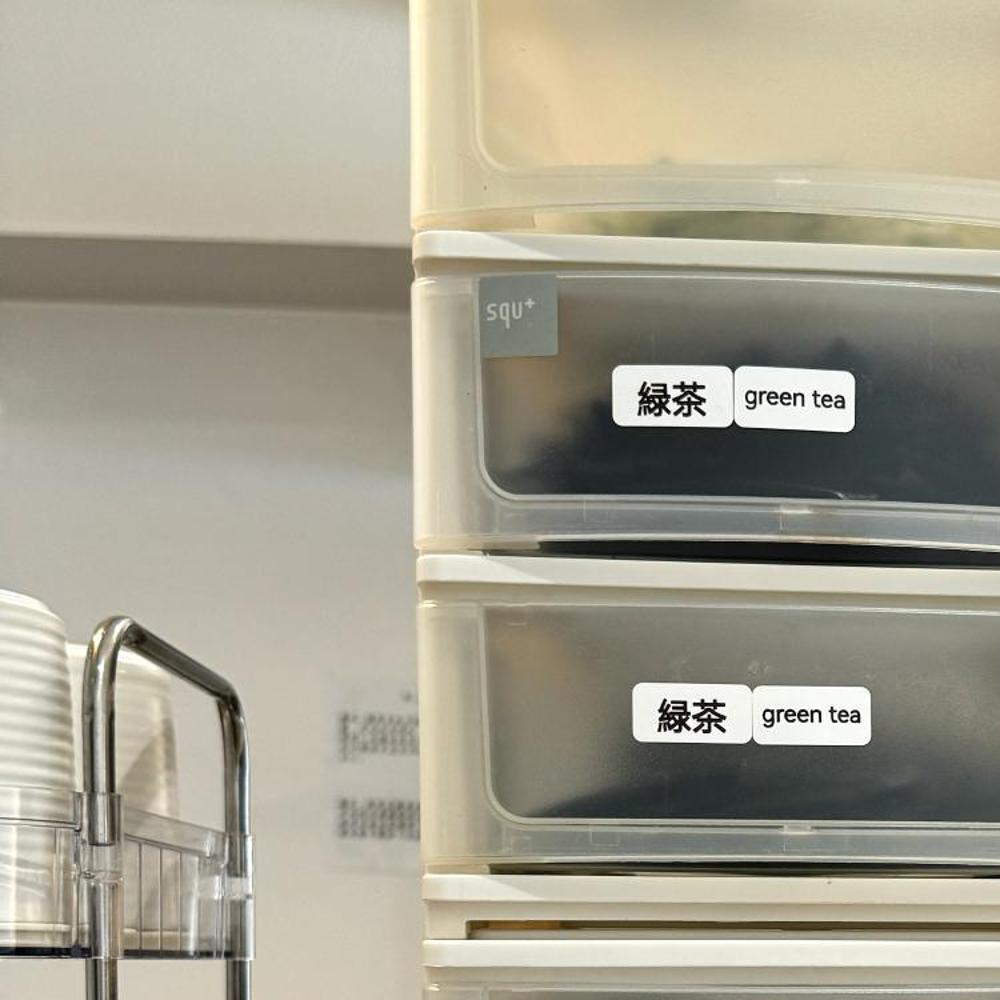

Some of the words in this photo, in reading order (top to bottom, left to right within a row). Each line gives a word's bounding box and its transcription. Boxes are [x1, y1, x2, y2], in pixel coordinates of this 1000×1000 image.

[636, 380, 708, 419] 緑茶
[744, 389, 806, 411] green
[811, 389, 847, 410] tea
[656, 697, 728, 735] 緑茶
[761, 707, 823, 728] green
[827, 705, 862, 724] tea
